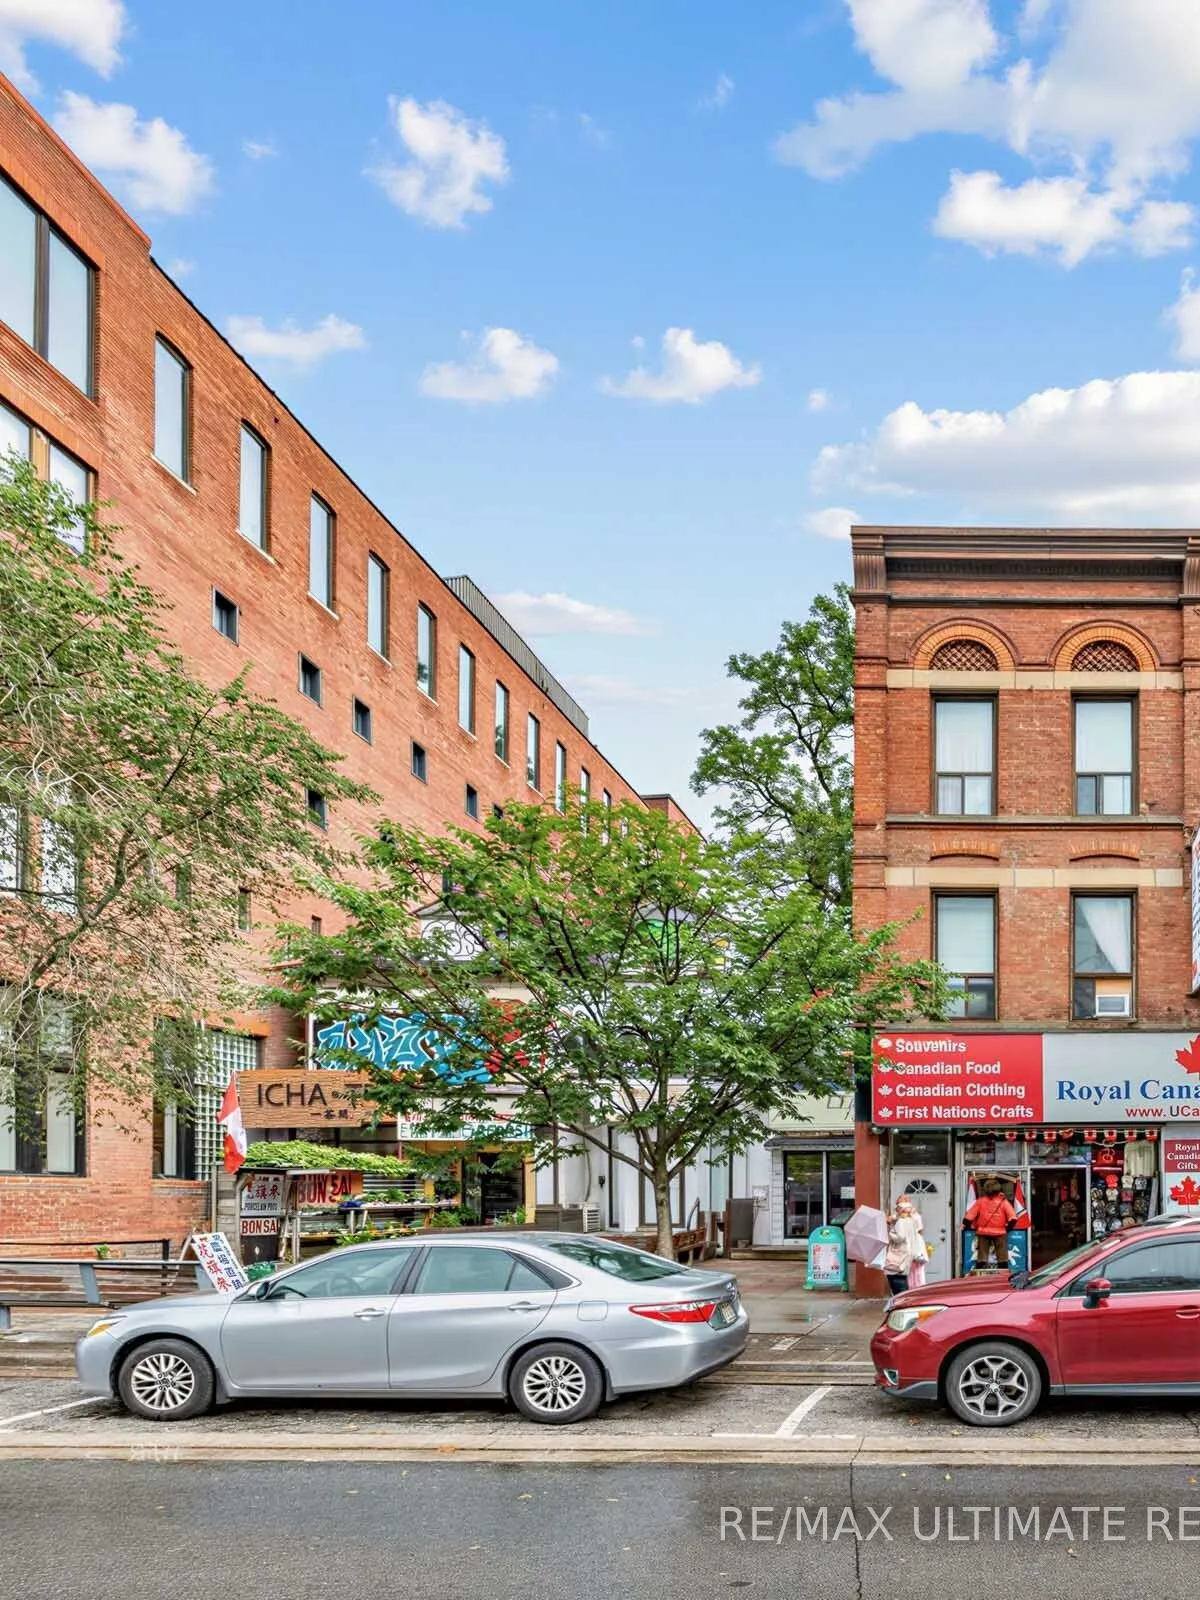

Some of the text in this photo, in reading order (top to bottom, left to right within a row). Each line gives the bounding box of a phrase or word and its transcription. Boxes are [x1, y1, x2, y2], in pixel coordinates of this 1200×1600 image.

[896, 1038, 967, 1053] Souvenirs
[896, 1062, 1001, 1075] Canadian Food
[257, 1083, 327, 1106] ICHA
[896, 1083, 1025, 1099] Canadian Clothing
[1056, 1079, 1130, 1106] Royal
[896, 1104, 1034, 1119] First Nations Crafts
[1175, 1143, 1200, 1153] Royal
[1177, 1161, 1199, 1170] Gifts
[242, 1219, 261, 1234] BON
